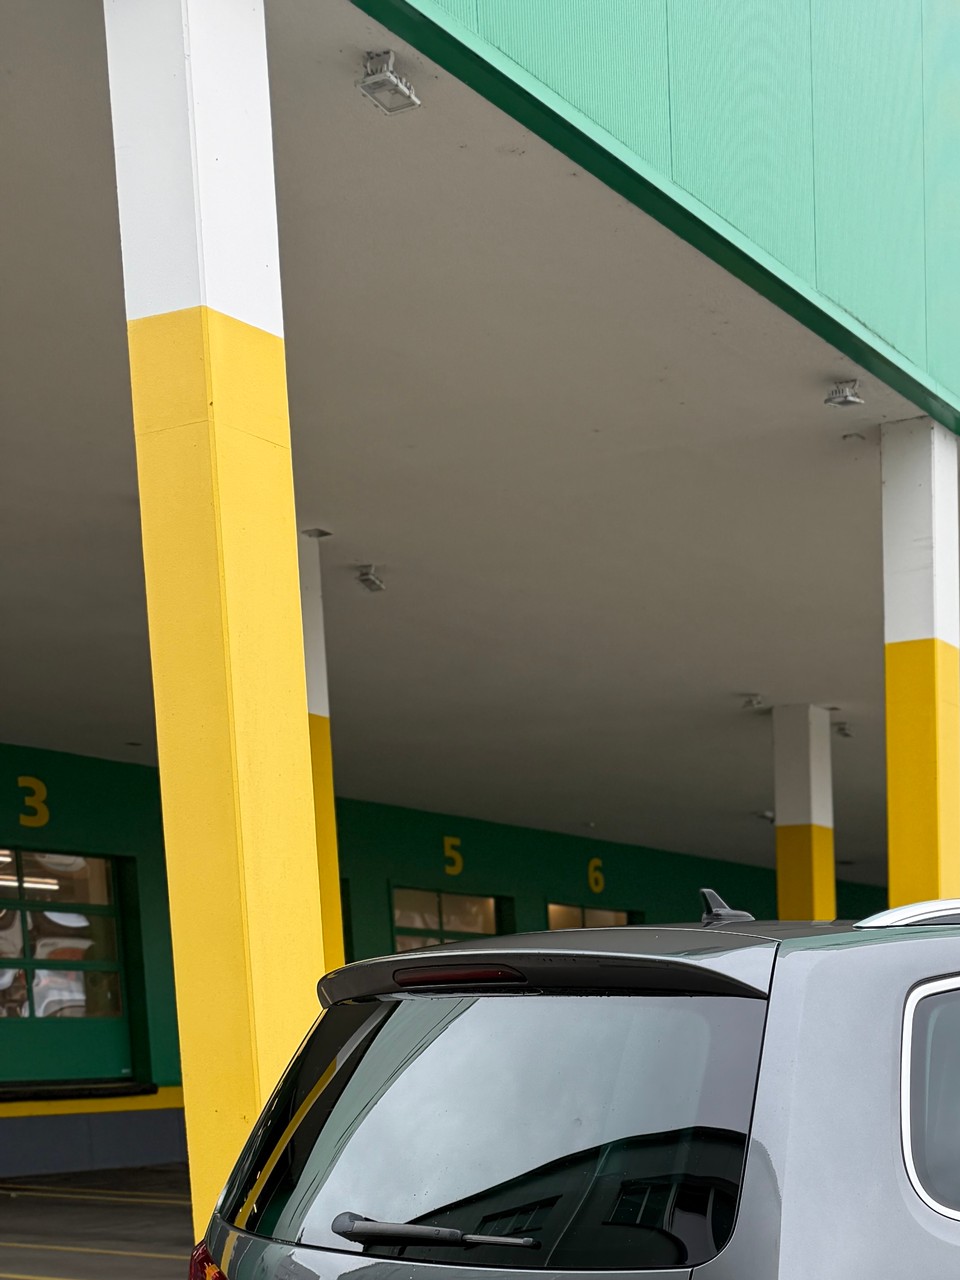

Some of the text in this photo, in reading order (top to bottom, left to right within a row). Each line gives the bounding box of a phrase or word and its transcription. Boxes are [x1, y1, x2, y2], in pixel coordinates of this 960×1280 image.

[17, 776, 50, 828] 3
[443, 836, 464, 876] 5
[588, 857, 605, 894] 6
